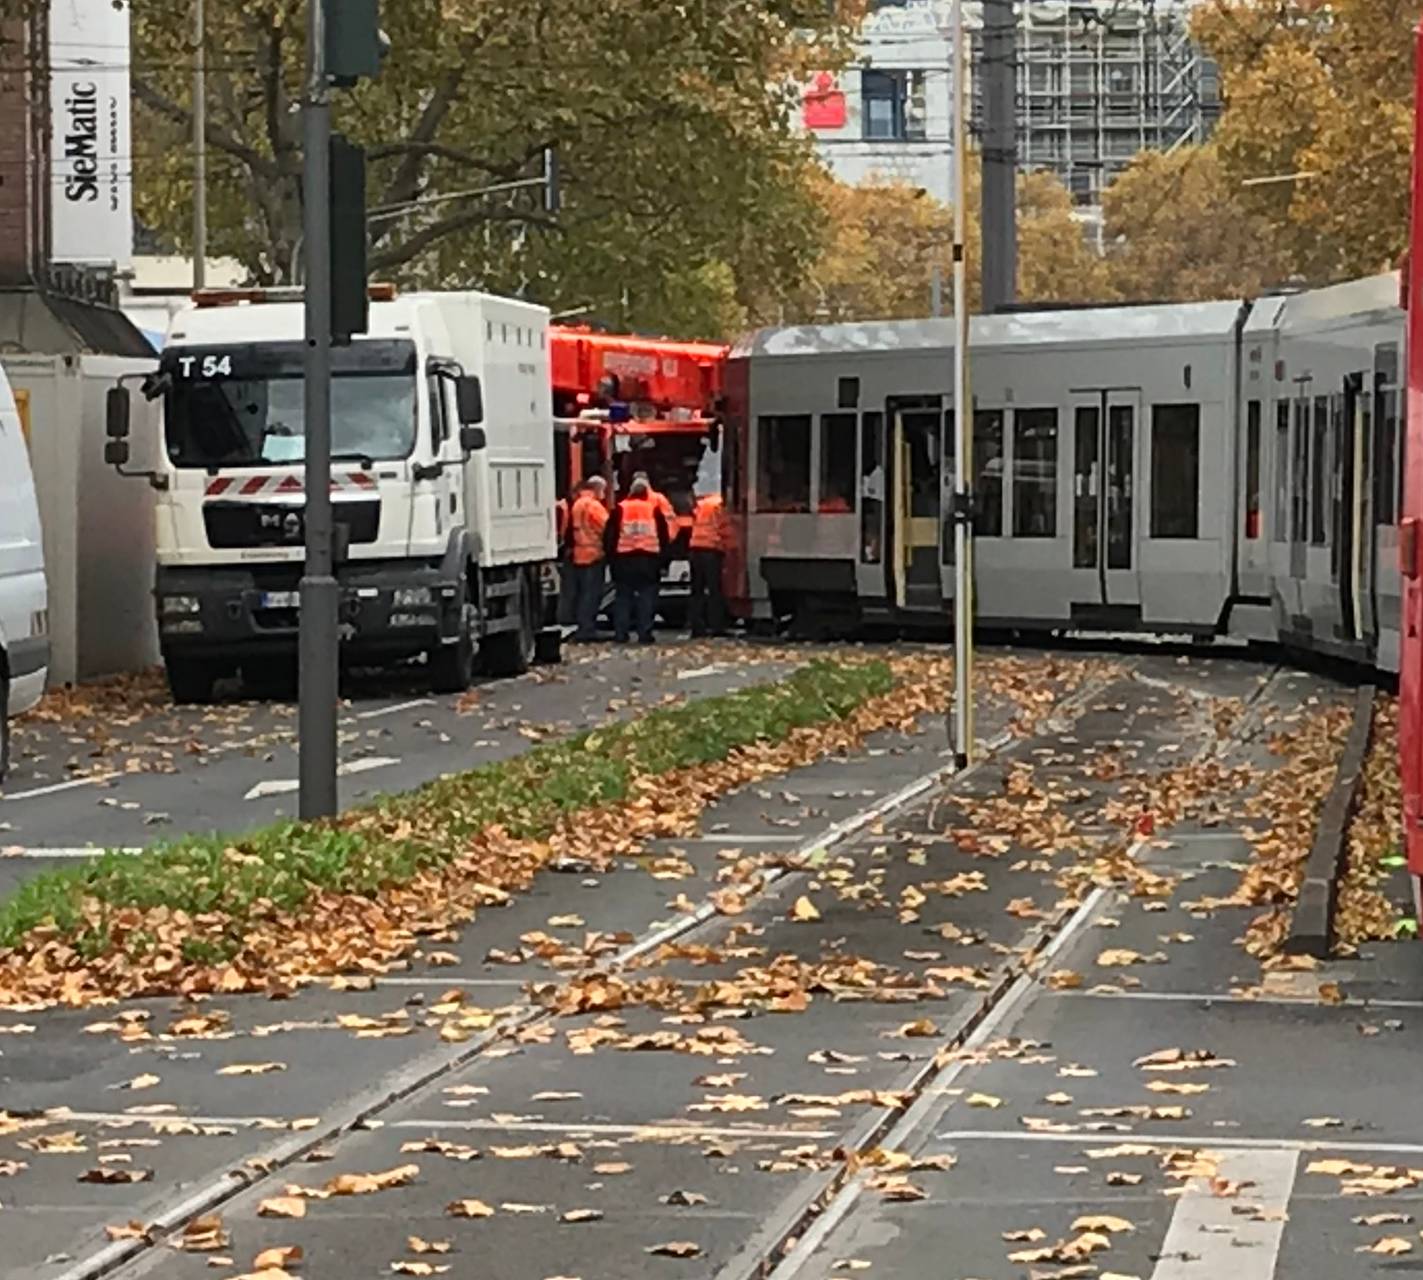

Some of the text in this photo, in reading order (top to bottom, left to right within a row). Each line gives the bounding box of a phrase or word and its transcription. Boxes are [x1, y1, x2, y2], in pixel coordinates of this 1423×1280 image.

[64, 82, 98, 202] SieMatic
[179, 355, 232, 377] T 54
